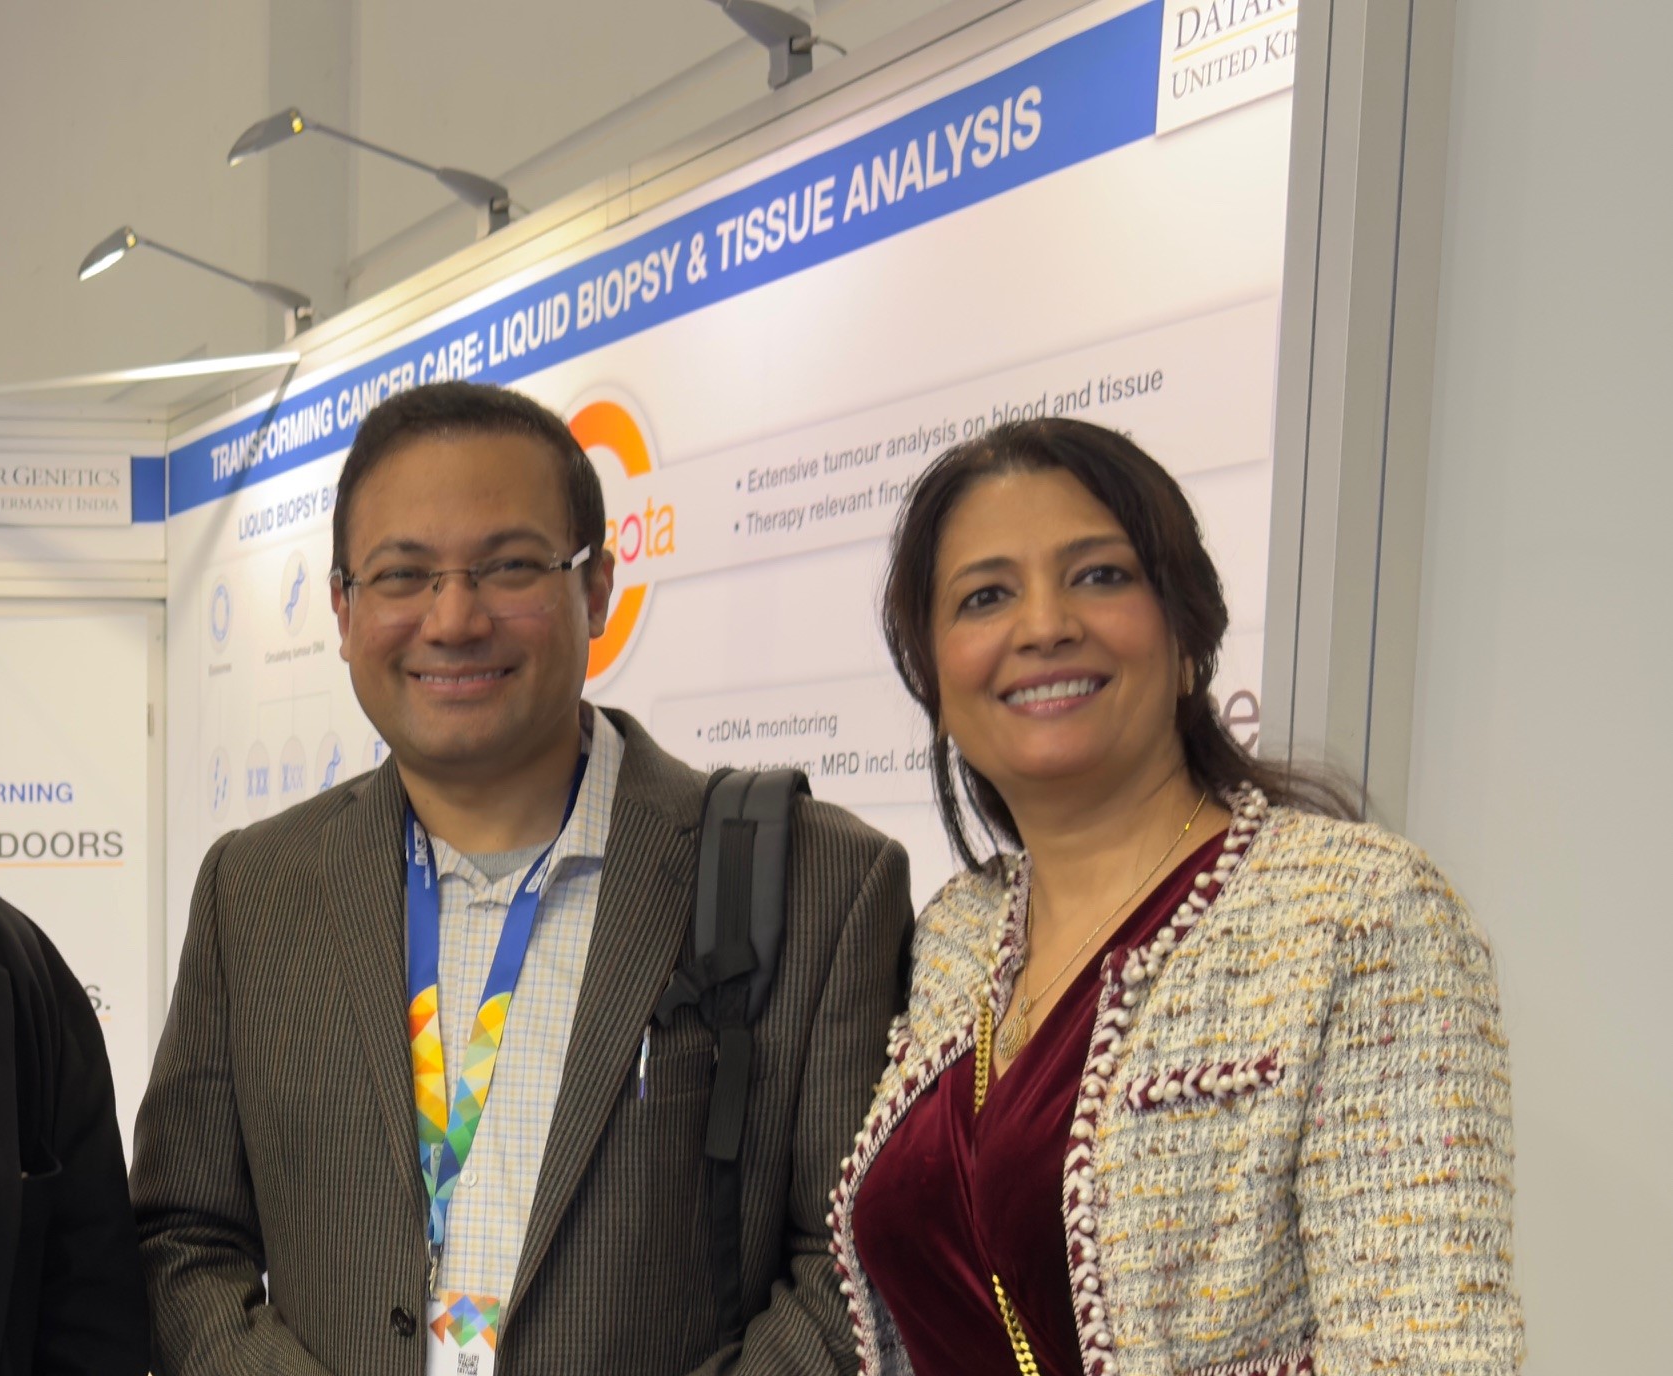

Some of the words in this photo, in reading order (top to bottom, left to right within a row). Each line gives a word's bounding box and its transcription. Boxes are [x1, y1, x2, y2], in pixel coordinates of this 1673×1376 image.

[1172, 45, 1257, 99] UNITED
[211, 397, 334, 482] TRANSFORMING
[336, 361, 415, 430] CANCER
[419, 331, 485, 386] CARE:
[489, 292, 571, 367] LIQUID
[577, 240, 682, 331] BIOPSY
[686, 232, 708, 284] &
[716, 175, 836, 271] TISSUE
[844, 85, 1043, 225] ANALYSIS
[747, 462, 818, 492] Extensive
[823, 442, 882, 474] tumour
[886, 417, 957, 457] analysis
[963, 415, 986, 437] on
[1053, 381, 1091, 417] and
[1098, 368, 1163, 404] tissue
[12, 466, 120, 487] GENETICS
[76, 498, 119, 512] INDIA
[239, 506, 274, 540] LIQUID
[277, 491, 320, 531] BIOPSY
[746, 505, 805, 537] Therapy
[809, 488, 873, 520] relevant
[708, 719, 751, 743] ctDNA
[756, 711, 838, 737] monitoring
[821, 752, 859, 777] MRD
[865, 750, 898, 774] incl.
